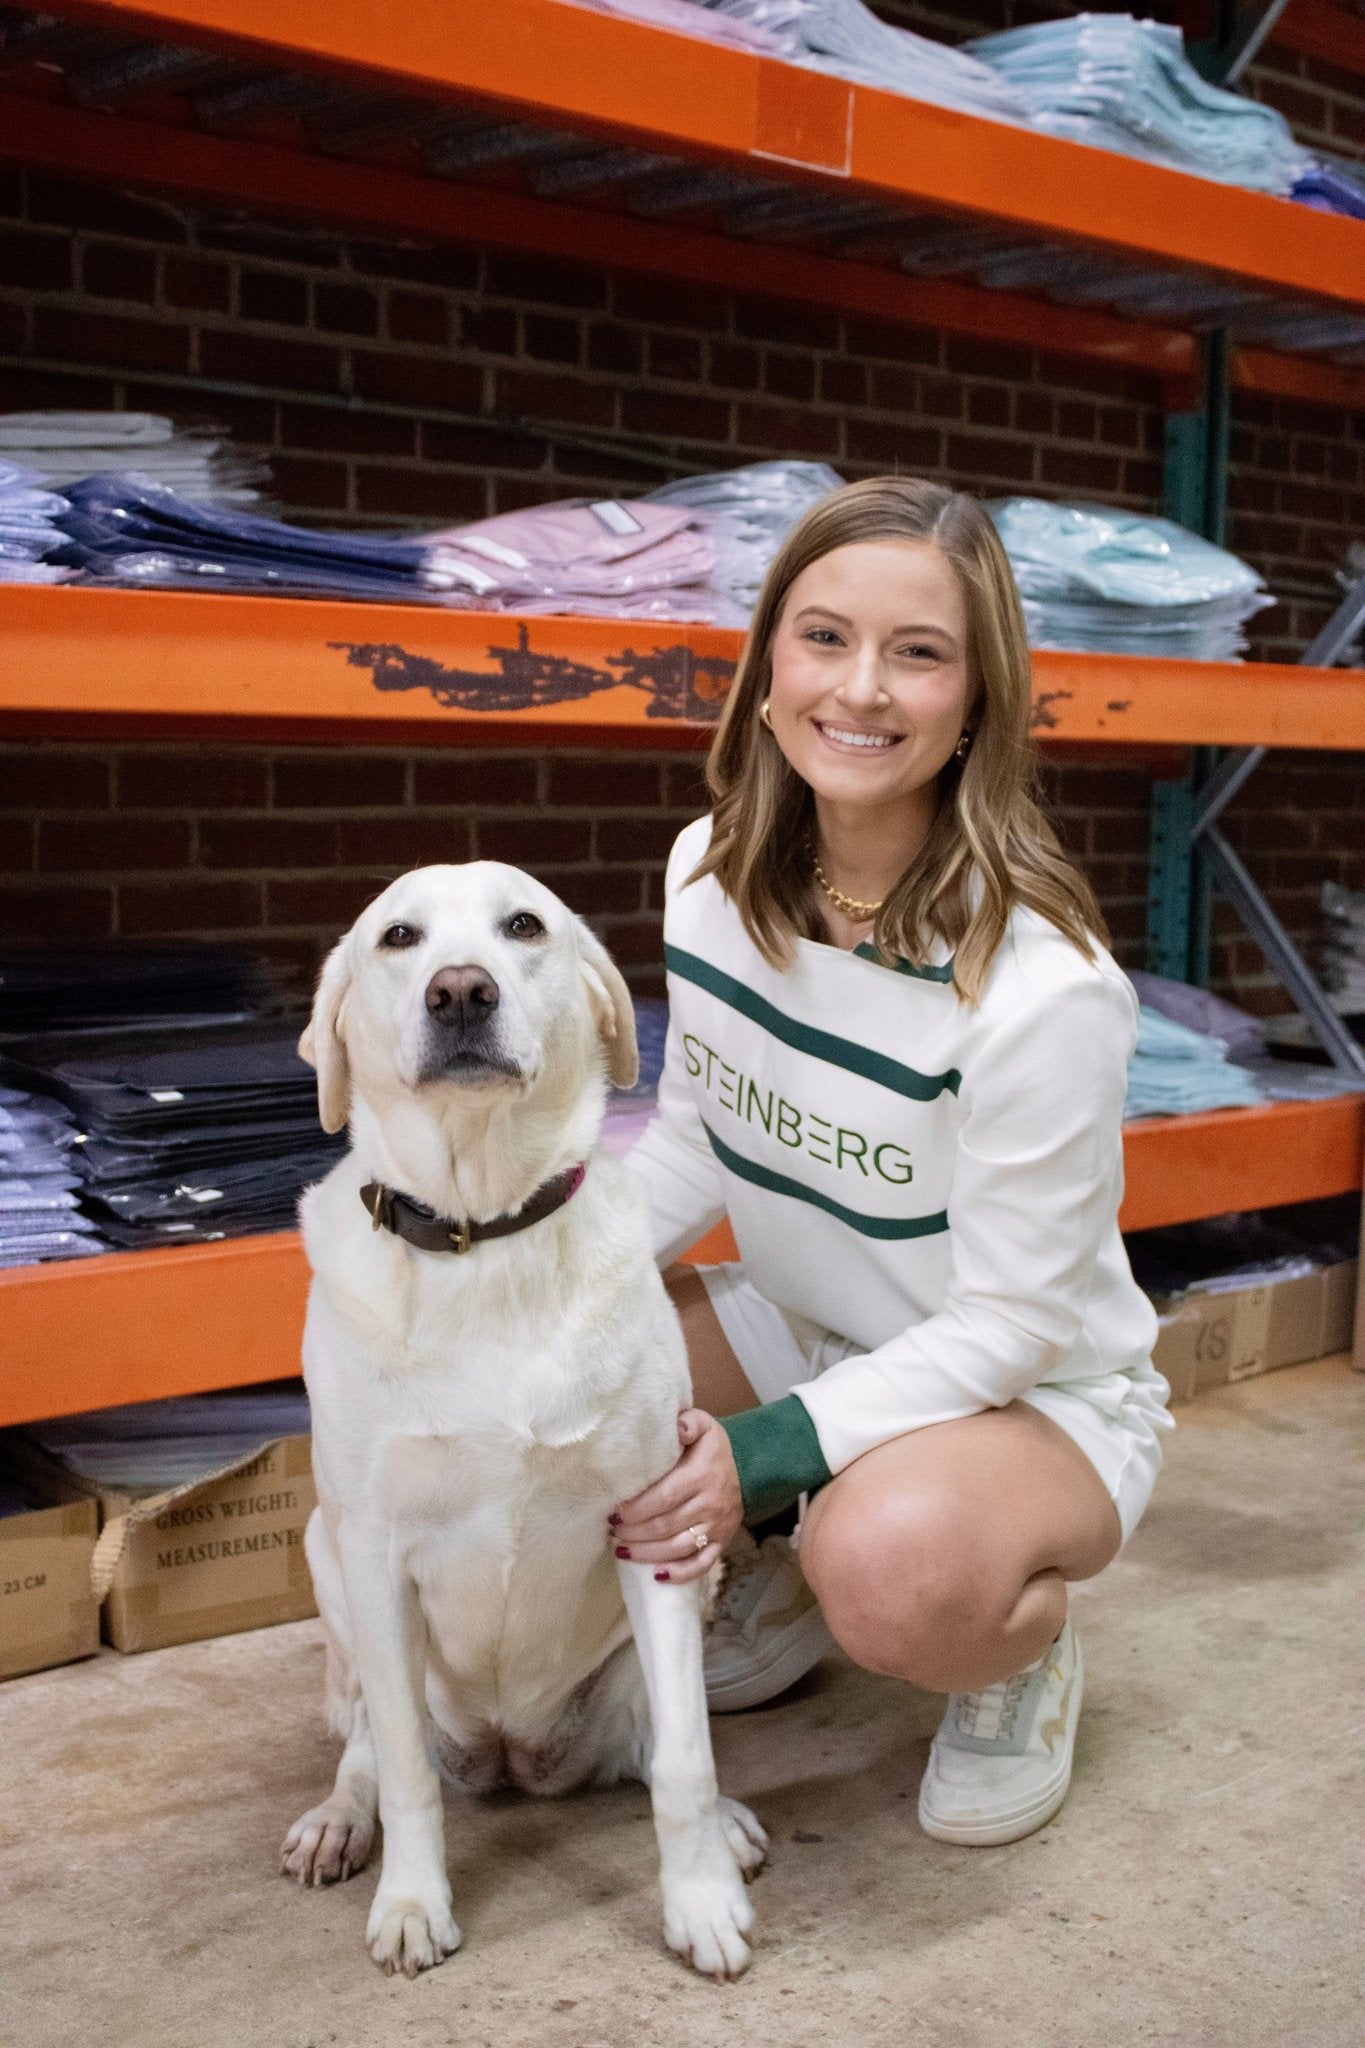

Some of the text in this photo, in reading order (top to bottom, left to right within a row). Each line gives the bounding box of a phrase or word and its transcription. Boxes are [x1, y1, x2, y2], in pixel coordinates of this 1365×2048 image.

[683, 1033, 914, 1185] STEINBERG
[156, 1491, 298, 1530] GROSS WEIGHT:
